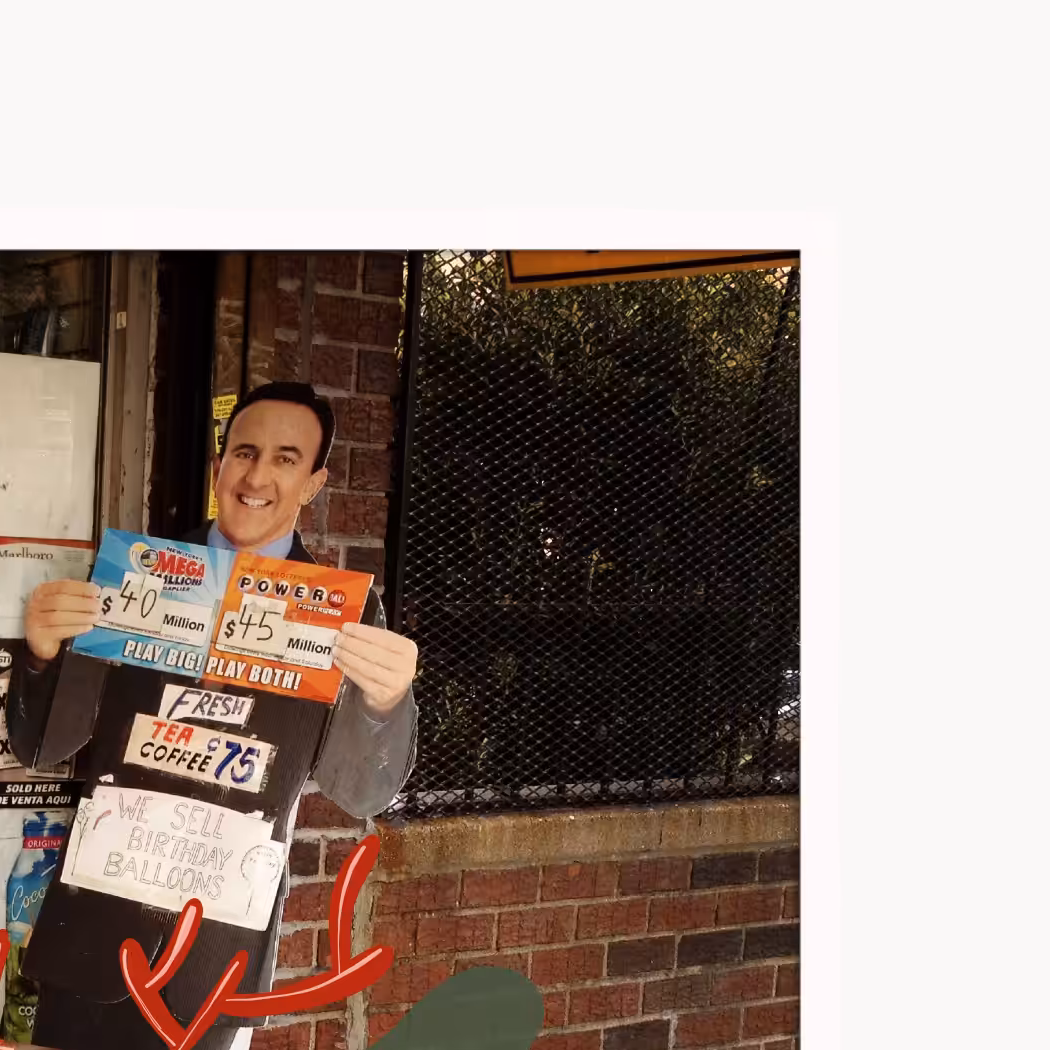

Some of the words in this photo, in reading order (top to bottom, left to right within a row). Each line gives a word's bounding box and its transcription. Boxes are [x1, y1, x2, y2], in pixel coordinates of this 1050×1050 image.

[152, 551, 206, 578] MEGA
[156, 574, 203, 587] ILLIONS
[240, 576, 326, 602] POWER
[120, 580, 158, 618] 40
[163, 613, 205, 632] Million
[239, 603, 281, 641] 45
[287, 638, 332, 656] Million
[123, 640, 164, 663] PLAY
[166, 647, 205, 672] BIG!
[206, 656, 247, 680] PLAY
[248, 664, 302, 691] BOTH!
[166, 688, 247, 720] FRESH
[151, 720, 194, 747] TEA
[140, 742, 212, 773] COFFEE
[5, 784, 32, 793] SOLD
[34, 783, 61, 792] HERE
[11, 796, 43, 805] VENTA
[46, 795, 71, 804] AQUI
[118, 792, 153, 823] WE
[170, 802, 224, 840] SELL
[28, 838, 63, 849] ORIGINA
[127, 826, 233, 871] BIRTHDAY
[103, 851, 224, 900] BALLOONS
